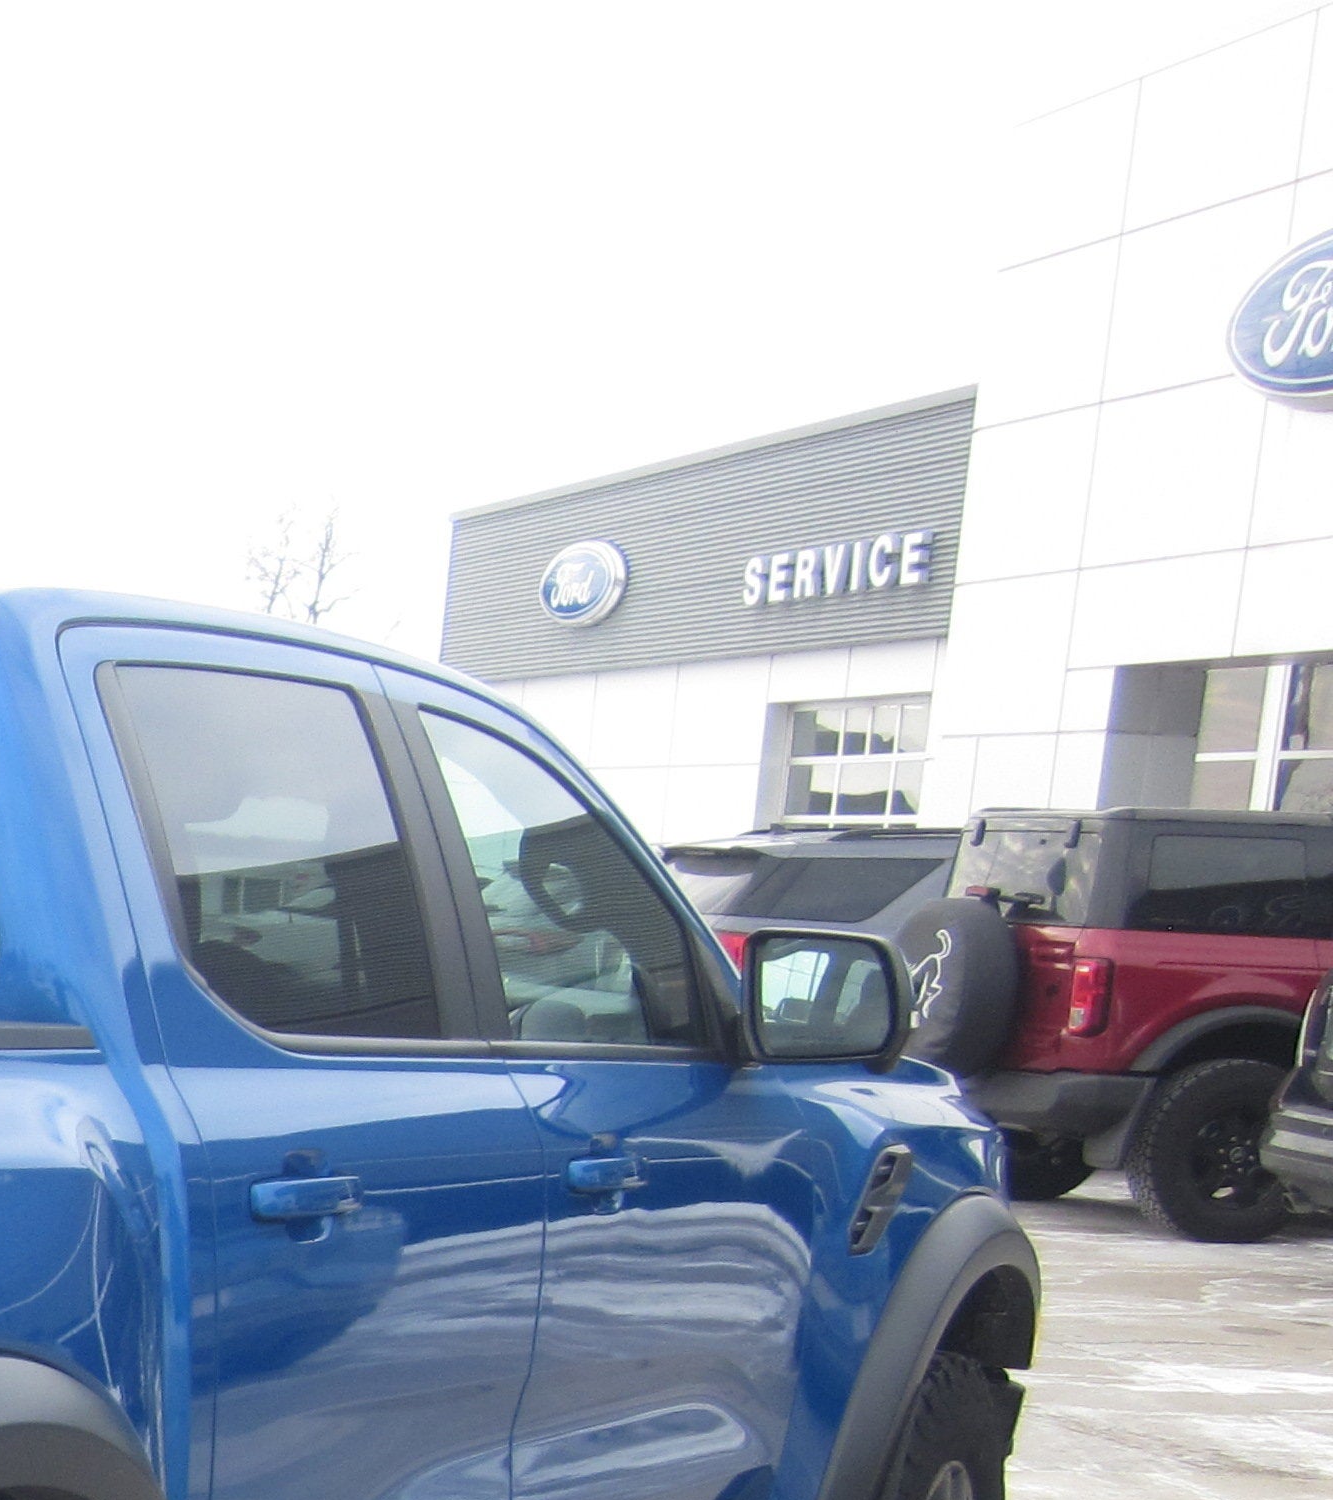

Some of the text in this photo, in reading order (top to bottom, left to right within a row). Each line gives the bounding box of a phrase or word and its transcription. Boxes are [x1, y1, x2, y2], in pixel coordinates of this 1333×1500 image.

[1261, 258, 1333, 369] Fo
[550, 562, 596, 609] Ford
[742, 529, 933, 607] SERVICE
